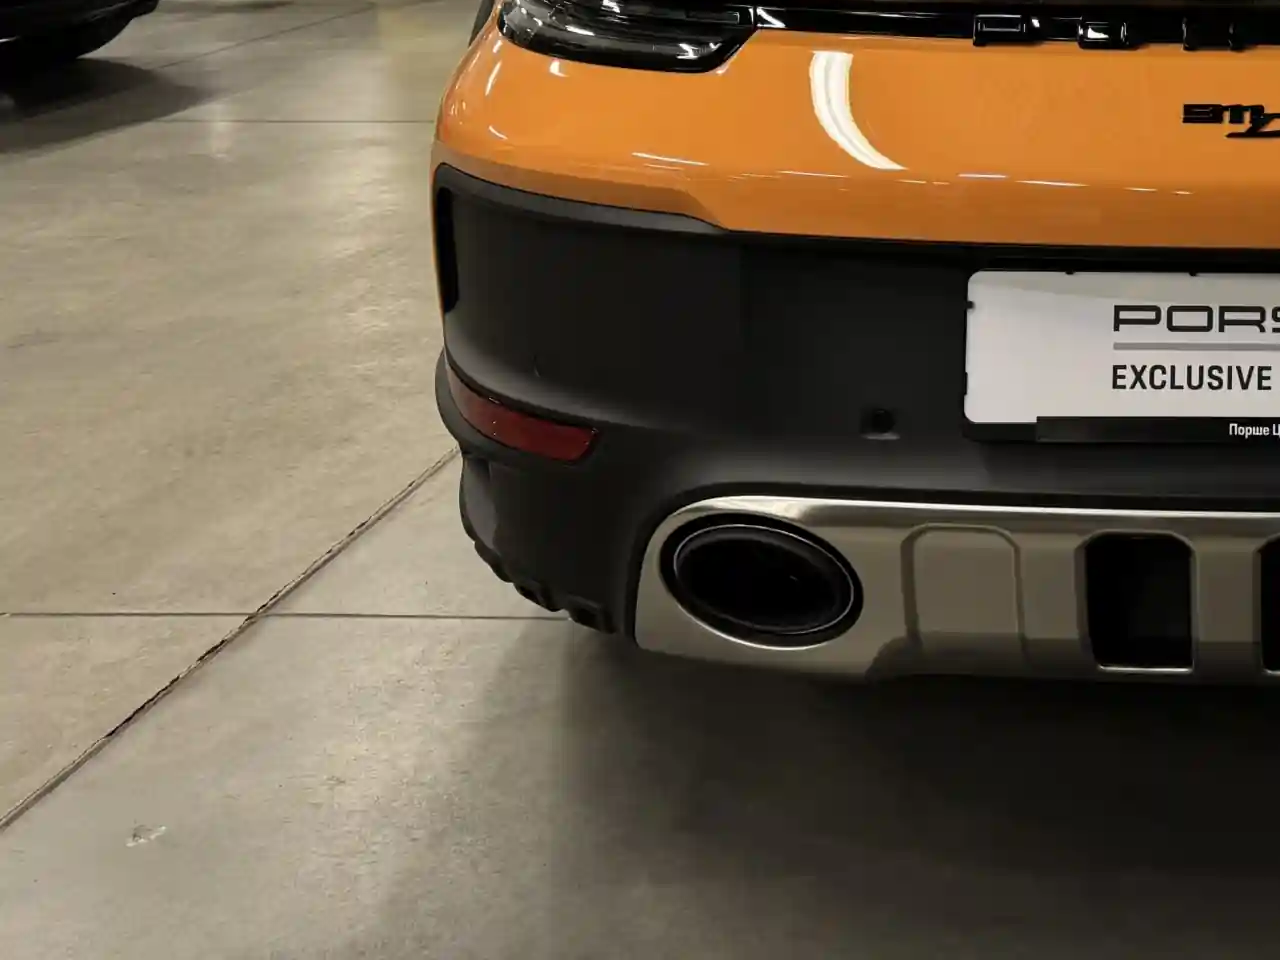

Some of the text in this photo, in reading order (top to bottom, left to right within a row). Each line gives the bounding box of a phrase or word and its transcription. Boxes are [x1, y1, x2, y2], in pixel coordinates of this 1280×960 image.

[1182, 103, 1265, 125] 911
[1111, 364, 1272, 391] EXCLUSIVE
[1229, 423, 1270, 439] Порше
